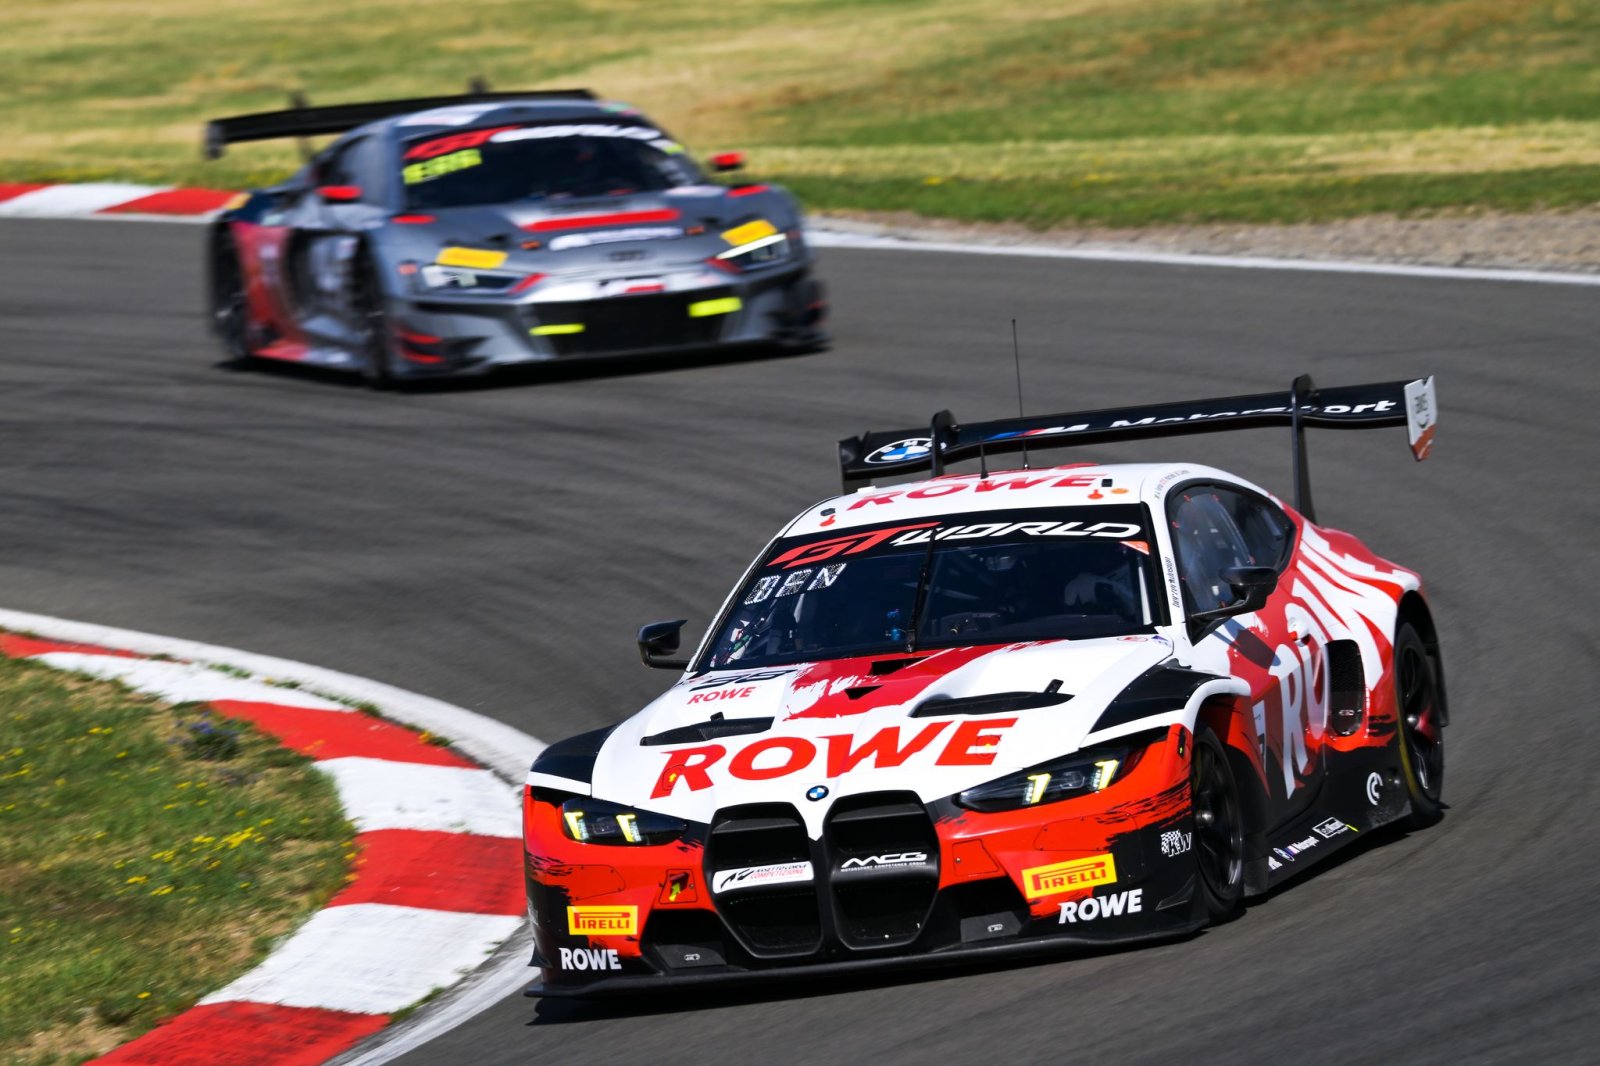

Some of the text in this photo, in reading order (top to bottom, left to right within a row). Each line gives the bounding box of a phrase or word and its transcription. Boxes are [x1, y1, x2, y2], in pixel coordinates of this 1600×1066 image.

[846, 473, 1107, 511] ROWE
[766, 521, 1141, 570] GT WORLD
[687, 686, 757, 705] ROWE
[649, 717, 1019, 800] ROWE
[841, 851, 927, 869] MCG
[1031, 861, 1107, 891] PIRELLI
[573, 911, 631, 929] PIRELLI
[1058, 888, 1143, 924] ROWE
[558, 947, 623, 971] ROWE
